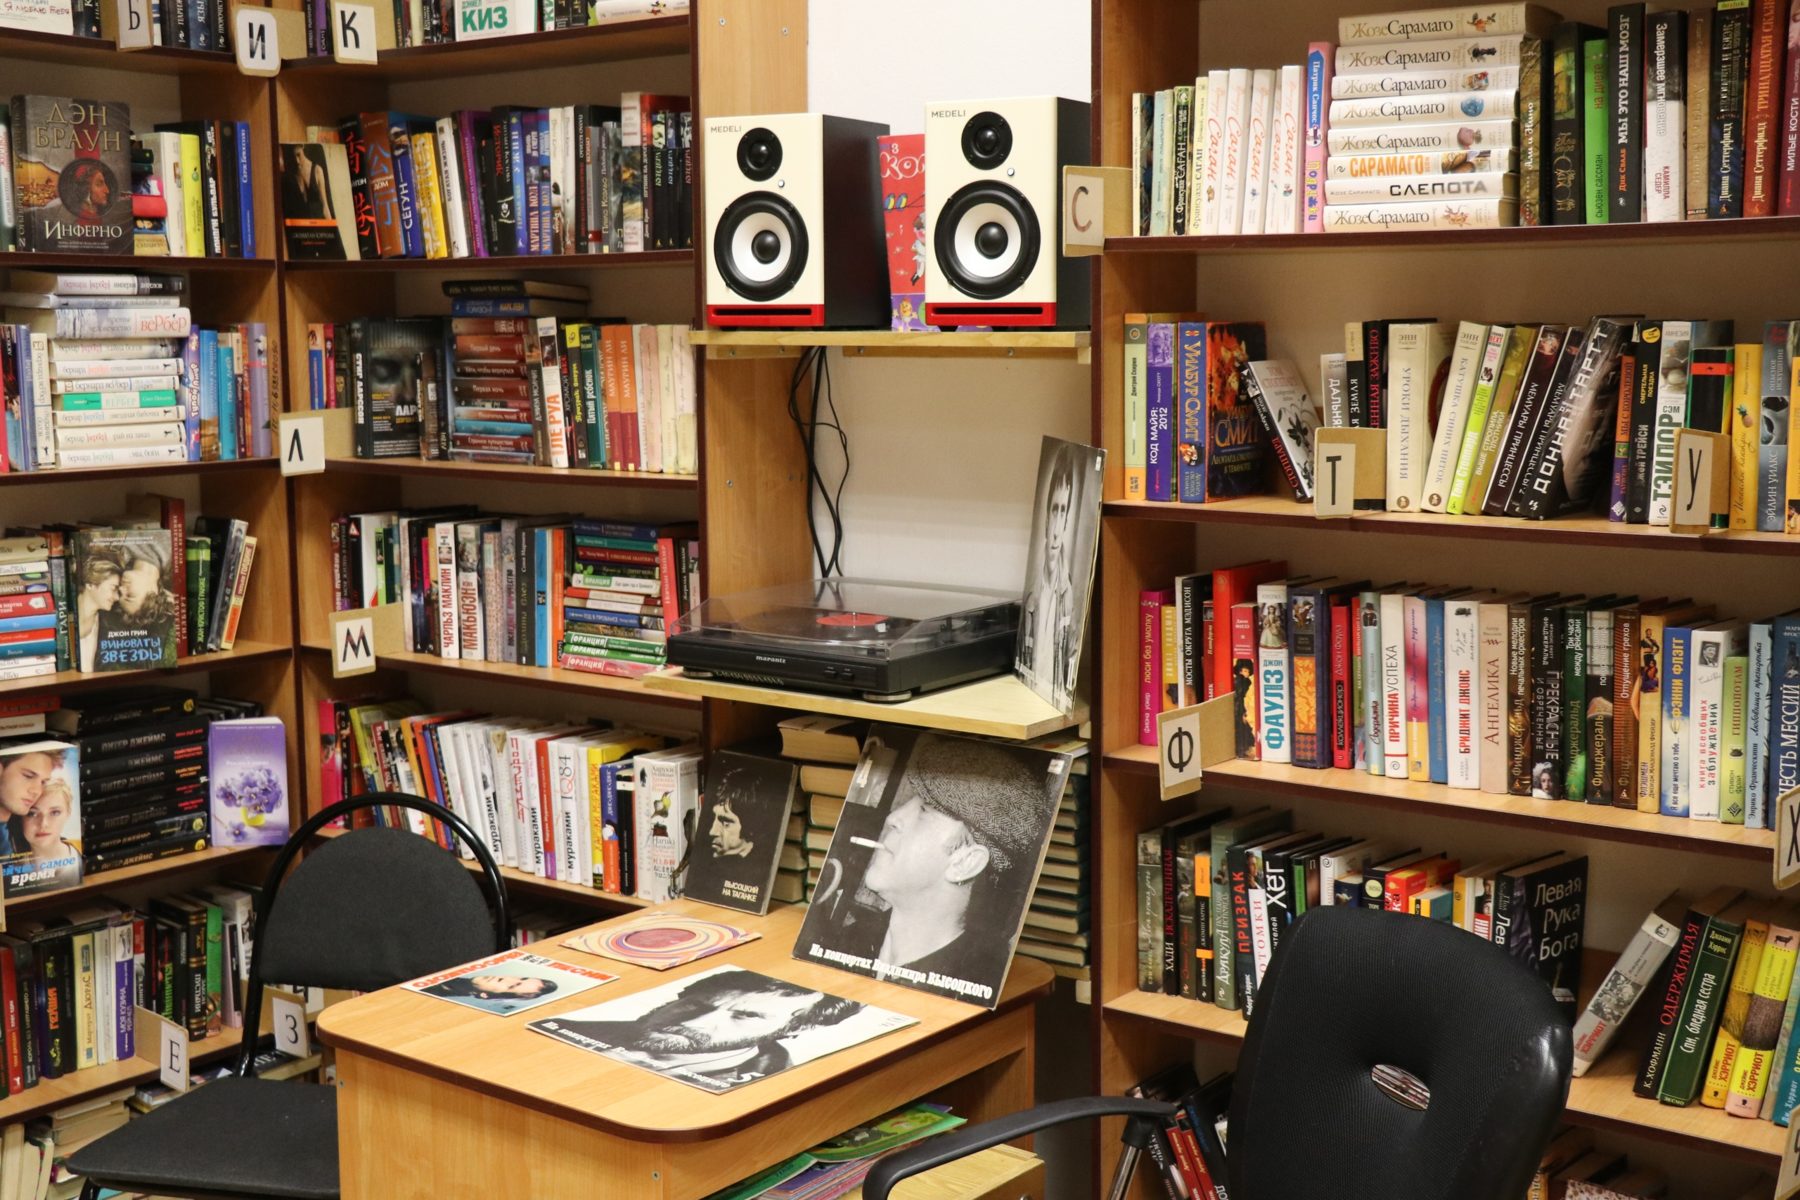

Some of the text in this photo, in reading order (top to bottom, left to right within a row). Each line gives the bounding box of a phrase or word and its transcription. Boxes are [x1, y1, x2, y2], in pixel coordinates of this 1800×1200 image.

[340, 10, 360, 49] К
[462, 7, 508, 32] КИЗ
[249, 22, 265, 60] И
[1656, 23, 1668, 81] Замерзшее
[1618, 14, 1630, 144] МЫ ЭТО НАШ МОЗГ
[47, 103, 107, 127] ДЭН
[931, 110, 966, 119] MEDELI
[1311, 94, 1320, 123] Санчес
[1526, 102, 1534, 138] Нино
[1752, 35, 1775, 202] Диана Сеттерфилд ТРИНАДЦАТАЯ
[35, 126, 121, 151] БРАУН
[710, 125, 742, 134] MEDELI
[891, 143, 899, 154] 3
[1786, 97, 1799, 171] МИЛЫЕ КОСТИ
[1177, 143, 1187, 178] САГАН
[1350, 155, 1424, 177] САРАМАГО
[1720, 123, 1733, 202] Диана Сеттерфилд
[1390, 180, 1487, 196] СЛЕПОТА
[529, 185, 539, 252] МАРТИНА КОУЛ
[1071, 186, 1092, 232] С
[1369, 328, 1379, 384] ЗАЖИВО
[607, 356, 616, 398] МАУРИН
[622, 358, 630, 399] МАУРИН
[1185, 341, 1200, 440] УИЛБУР СМИТ
[1350, 378, 1359, 413] ЗЕМЛЯ
[356, 380, 364, 424] ЛАРССОН
[587, 397, 596, 424] Пятый
[1159, 407, 1167, 430] 2012
[1435, 358, 1469, 484] КАТУШКА СИНИХ НИТОК
[288, 428, 303, 461] Л
[1400, 368, 1411, 480] УРОКИ ДЫХАНИЯ
[1489, 411, 1504, 451] ПЛОТНИКИ
[1497, 382, 1539, 488] МЕМУАРЫ ПРИНЦЕССЫ
[1621, 422, 1628, 436] МЫ
[1635, 424, 1649, 459] ТРЕЙСИ
[1452, 431, 1479, 498] Том Стоппард
[1476, 453, 1488, 475] ВЫШЕ
[1534, 416, 1573, 493] ДОННА
[1326, 455, 1341, 505] Т
[1687, 448, 1702, 511] У
[1766, 450, 1778, 521] ЭЙЛИН УИЛКС
[58, 600, 66, 635] ГАРИ
[441, 569, 453, 647] ЧАРЛЬЗ МАКЛИН
[462, 585, 477, 650] МАКЬЮЭН
[1146, 613, 1154, 643] умолку
[101, 637, 161, 650] ВИНОВАТЫ
[108, 629, 147, 638] ДЖОН ГРИН
[342, 625, 371, 663] М
[1510, 617, 1518, 675] Новые мелодии
[101, 648, 163, 663] ЗВЕЗДЫ
[756, 655, 786, 664] marantz
[1263, 659, 1283, 667] ДЖОН
[1517, 617, 1526, 695] печальных оркестров
[1620, 622, 1630, 699] Отпущение грехов
[1386, 645, 1400, 742] ПРИЧИНА УСПЕХА
[1673, 638, 1684, 717] ФЭННИ ФЛЭГГ
[1264, 670, 1284, 749] ФАУЛЗ
[1459, 669, 1471, 754] БРИДЖИТ ДЖОНС
[1484, 658, 1500, 745] АНГЕЛИКА
[1536, 688, 1544, 750] ОБРЕЧЕННЫЕ
[1546, 671, 1559, 760] ПРЕКРАСНЫЕ
[1732, 666, 1743, 736] ГИППОПОТАМ
[1781, 684, 1800, 747] МЕССИЙ
[1371, 701, 1379, 745] Содержанка
[1749, 642, 1762, 819] Энрико Франческини Любовница президента
[102, 739, 129, 750] ПИТЕР
[1168, 727, 1194, 773] Ф
[1708, 703, 1718, 785] заблуждений
[485, 796, 499, 852] мураками
[558, 755, 575, 870] мураками 1Q84
[531, 807, 542, 864] мураками
[11, 870, 55, 884] время
[40, 857, 75, 869] самое
[722, 888, 758, 903] НА ТАГАНКЕ
[724, 880, 759, 894] ВЫСОЦКИЙ
[1534, 877, 1582, 907] Левая
[1164, 850, 1174, 971] ХАДИ ИСКАЛЕЧЕННАЯ
[1233, 871, 1249, 953] ПРИЗРАК
[1544, 904, 1580, 934] Рука
[810, 943, 926, 983] На концертах Владимира
[1217, 929, 1230, 985] ДРАКУЛА
[1539, 932, 1578, 960] Бога
[84, 975, 92, 1010] ДЮРАС
[119, 987, 127, 1015] КУЗИНА
[1644, 923, 1699, 1089] К. ХОФМАНН ОДЕРЖИМАЯ
[1680, 972, 1716, 1053] Спи, бледная сестра
[169, 1040, 180, 1073] Е
[1582, 1022, 1606, 1055] ХЭРРИОТ
[1719, 1041, 1736, 1082] ХЭРРИОТ
[1747, 1053, 1764, 1092] ХЭРРИОТ
